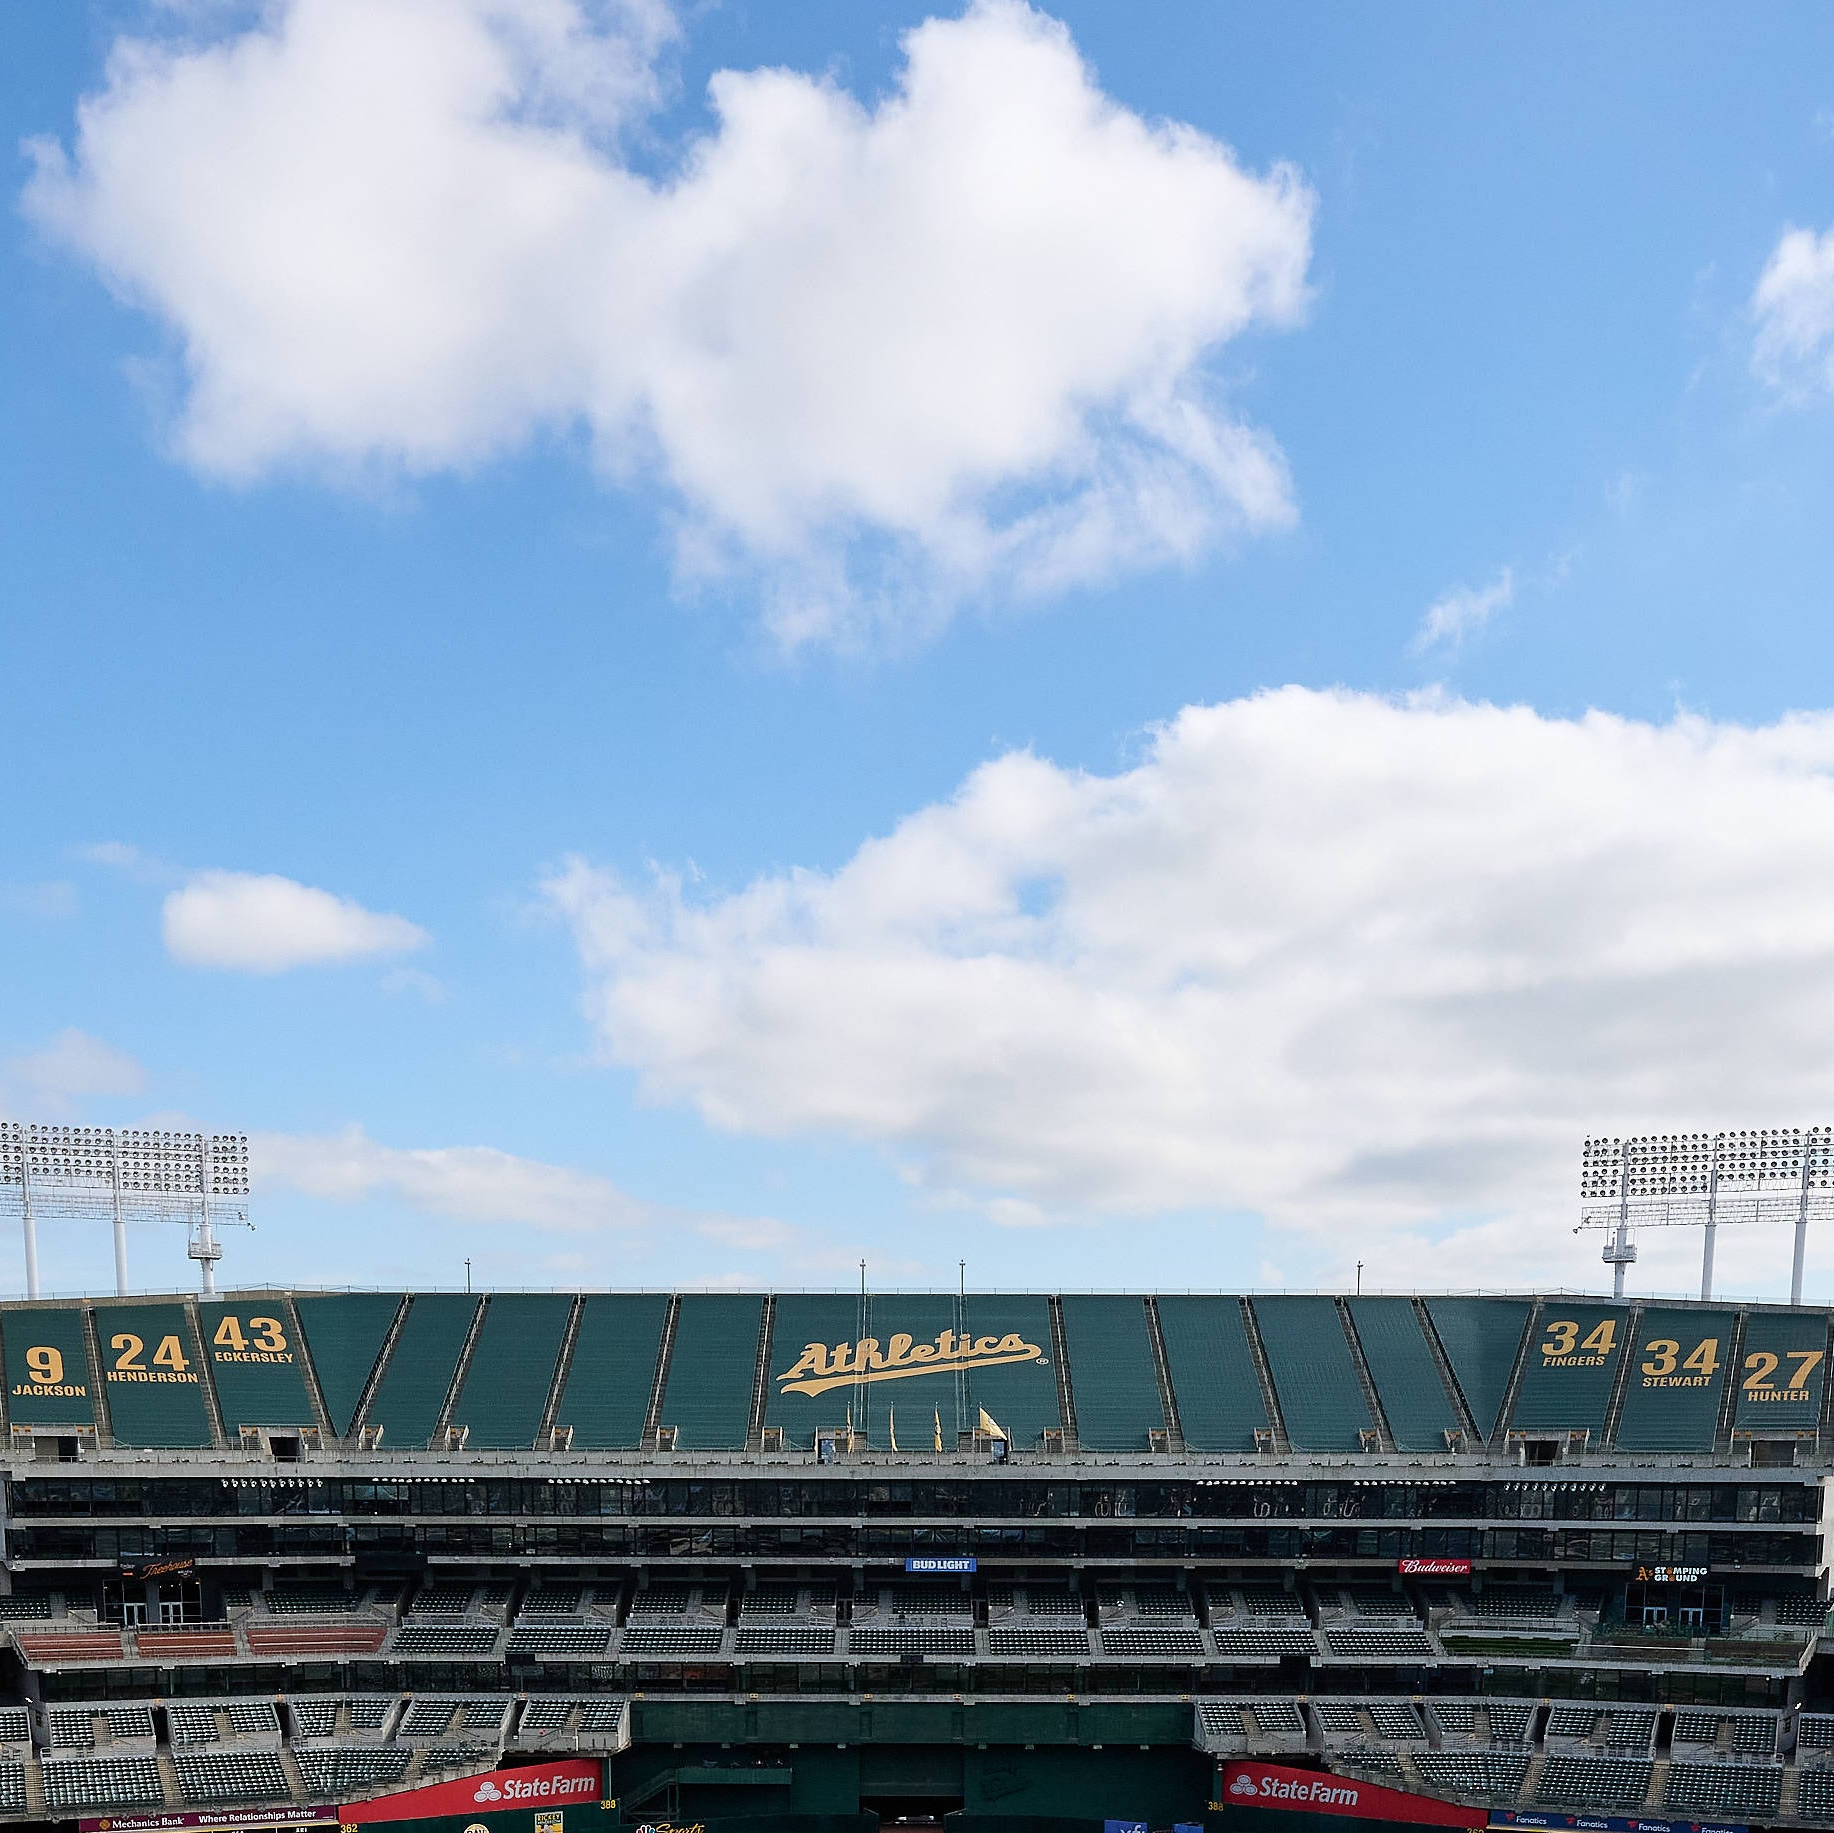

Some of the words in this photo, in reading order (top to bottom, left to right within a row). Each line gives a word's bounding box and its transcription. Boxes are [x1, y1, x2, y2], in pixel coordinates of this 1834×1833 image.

[213, 1316, 287, 1352] 43
[1541, 1320, 1617, 1355] 34
[110, 1333, 191, 1372] 24
[214, 1351, 293, 1365] ECKERSLEY
[1641, 1338, 1720, 1376] 34
[25, 1346, 64, 1385] 9
[776, 1328, 1043, 1397] Athletics
[1542, 1355, 1606, 1367] FINGERS
[1742, 1351, 1825, 1390] 27
[106, 1370, 198, 1385] HENDERSON
[1642, 1375, 1713, 1388] STEWART
[12, 1384, 87, 1398] JACKSON
[1747, 1389, 1810, 1402] HUNTER
[912, 1559, 935, 1572] BUD
[937, 1559, 970, 1572] LIGHT
[1401, 1559, 1469, 1574] Budweiser
[600, 1800, 616, 1810] 388
[1208, 1801, 1224, 1812] 388
[112, 1819, 161, 1829] Mechanics
[161, 1817, 183, 1827] Bank
[198, 1814, 227, 1824] Where
[229, 1811, 286, 1822] Relationships
[287, 1810, 317, 1820] Matter
[537, 1813, 561, 1821] RICKEY
[1516, 1816, 1547, 1825] Fanatics
[340, 1823, 358, 1833] 362
[1577, 1819, 1608, 1829] Fanatics
[1638, 1823, 1671, 1833] Fanatics
